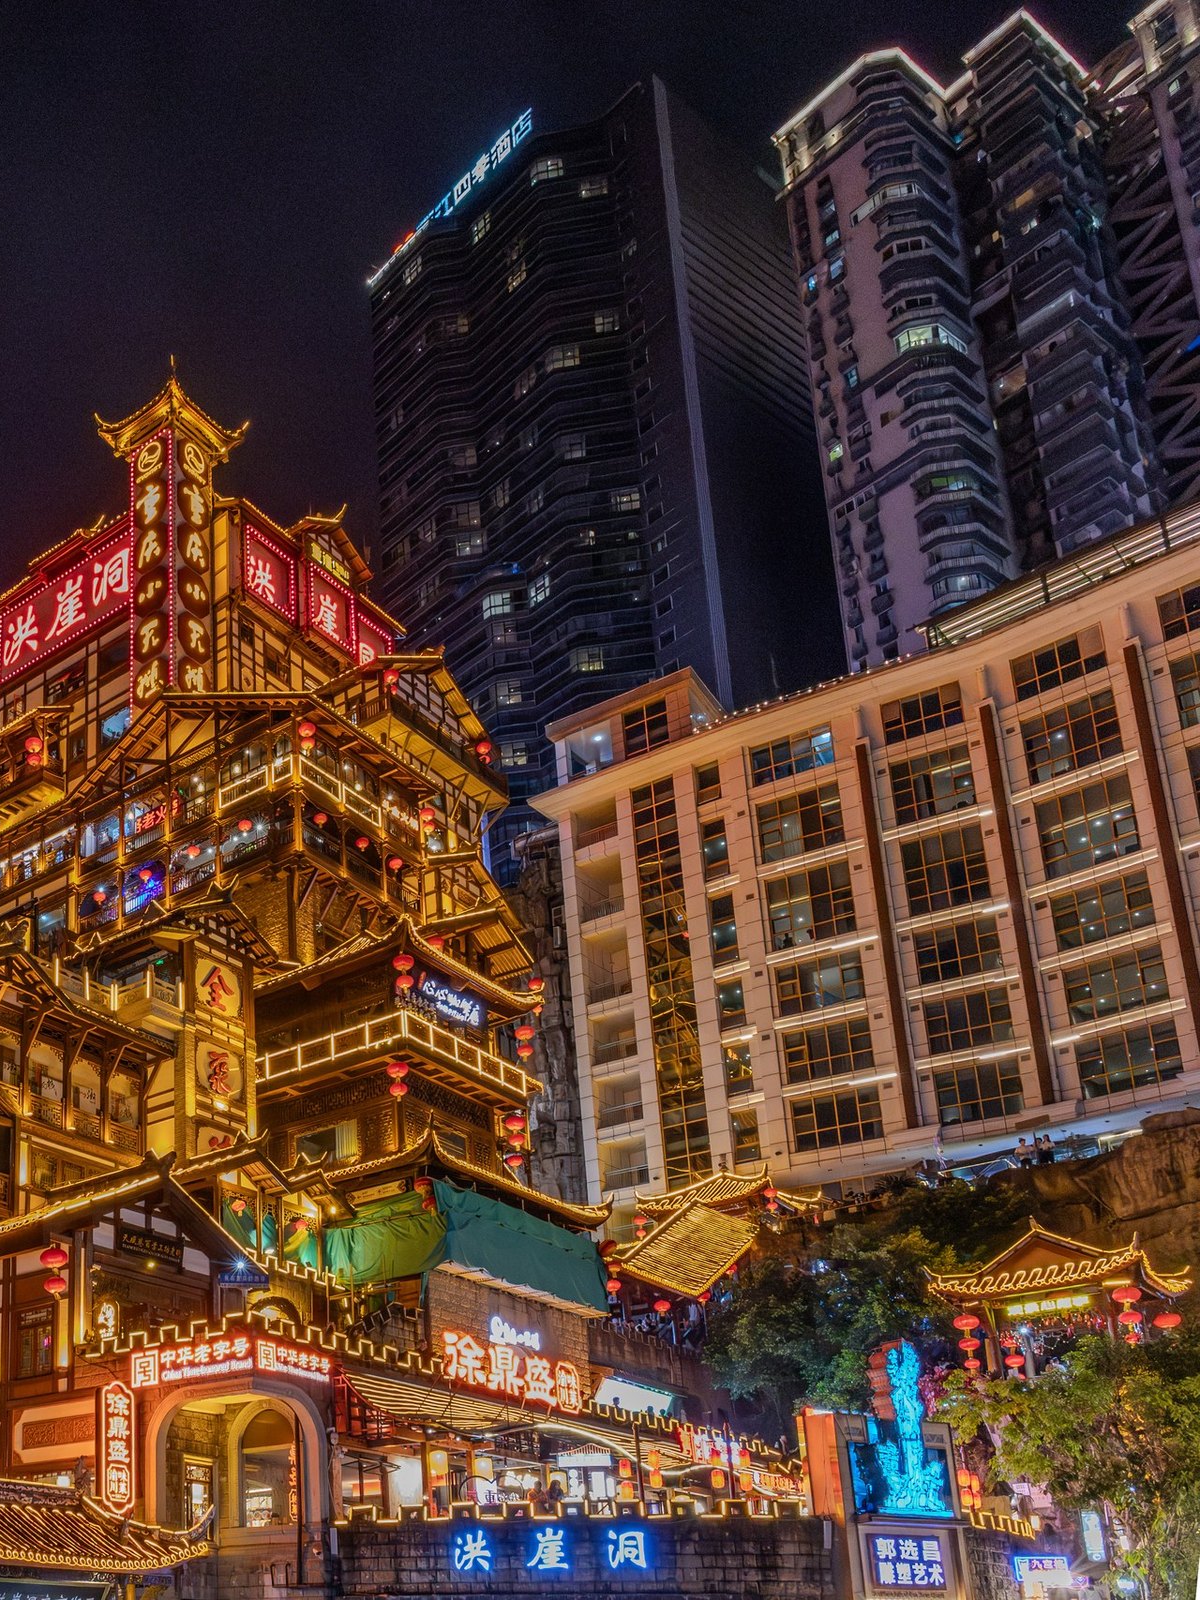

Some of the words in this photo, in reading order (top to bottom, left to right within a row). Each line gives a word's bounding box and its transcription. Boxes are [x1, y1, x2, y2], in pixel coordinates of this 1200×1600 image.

[3, 547, 130, 667] 洪崖洞
[160, 1337, 250, 1369] 中华老字号
[277, 1346, 331, 1373] 中华老字号
[444, 1331, 557, 1407] 徐鼎盛
[106, 1393, 131, 1463] 徐鼎盛
[454, 1527, 647, 1571] 洪崖洞
[875, 1537, 941, 1562] 郭选昌
[878, 1562, 944, 1586] 雕塑艺术
